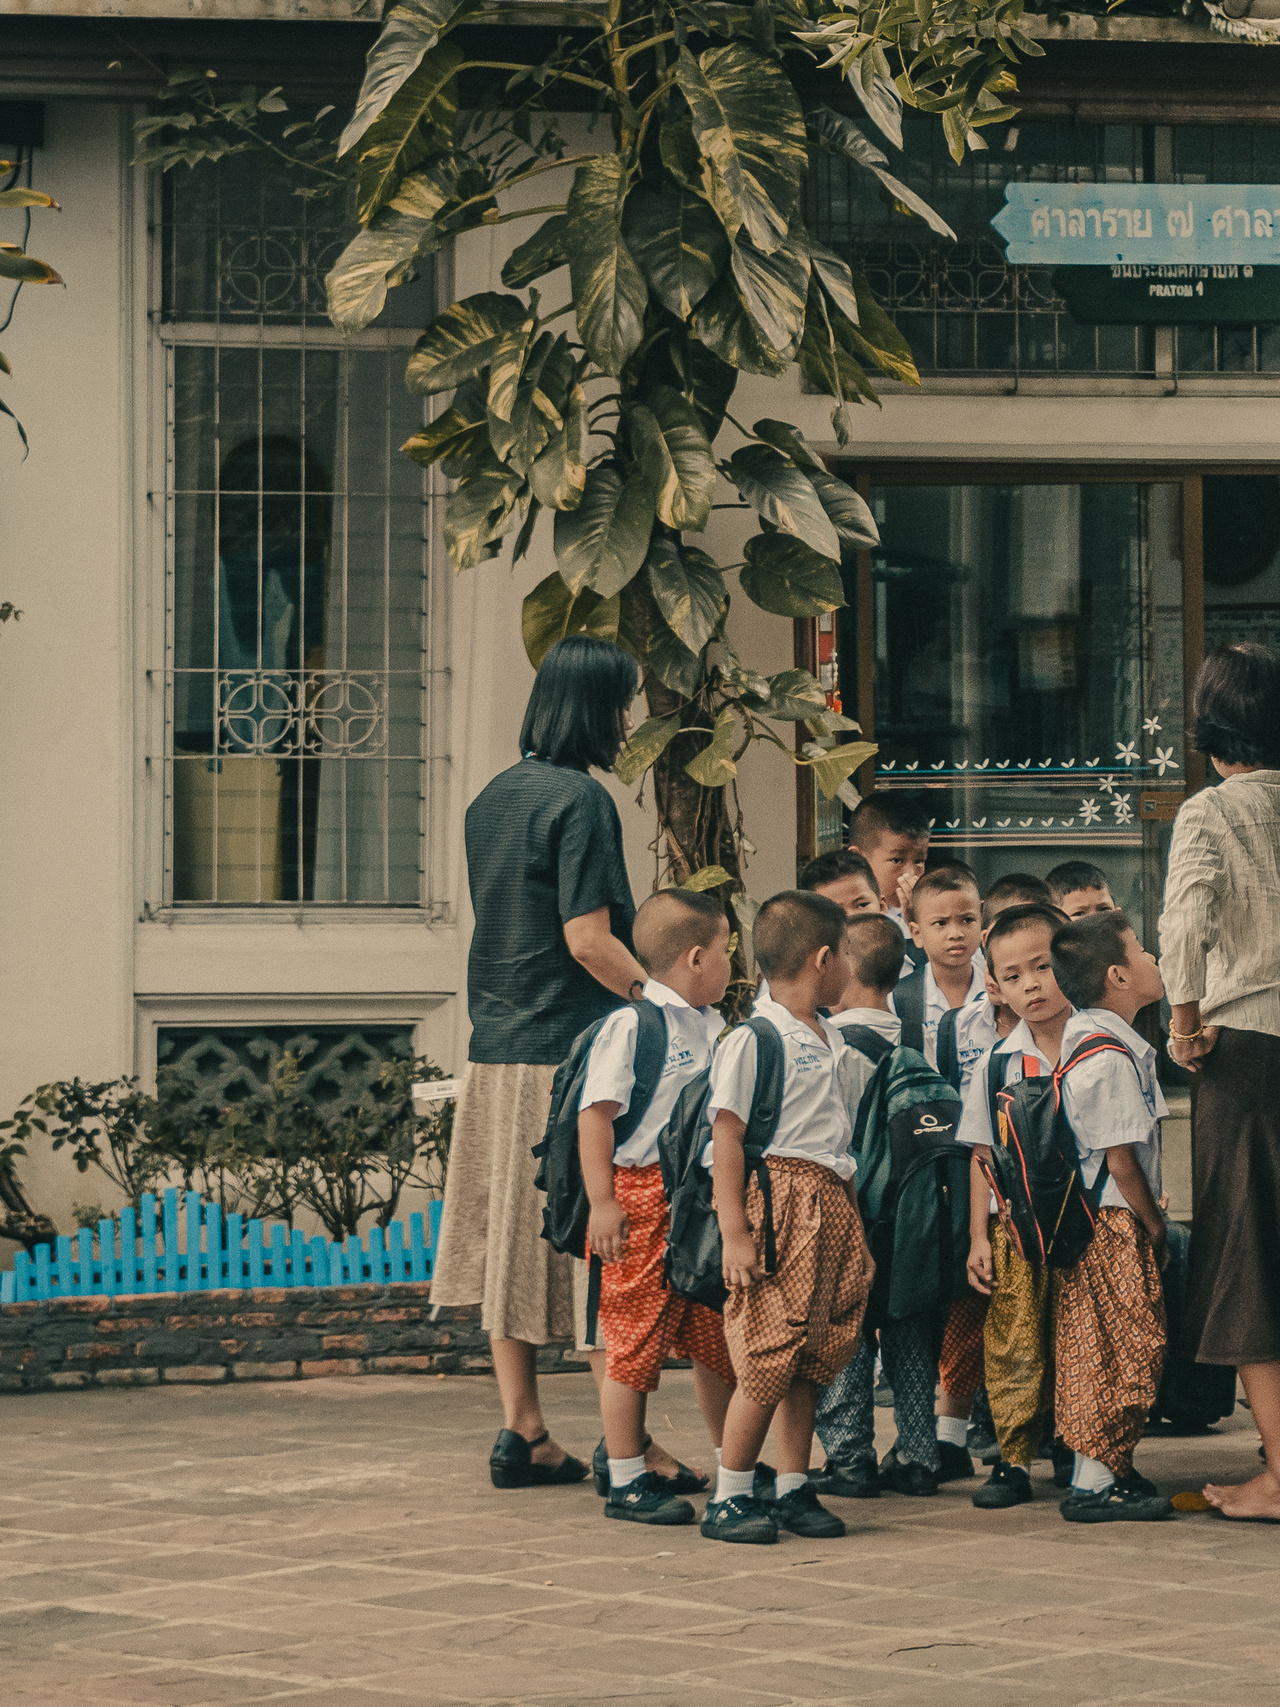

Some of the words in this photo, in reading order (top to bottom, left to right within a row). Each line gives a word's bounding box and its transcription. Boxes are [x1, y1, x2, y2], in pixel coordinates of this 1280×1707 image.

[1031, 205, 1153, 238] ศาลาราย
[1149, 284, 1193, 297] PRATOM
